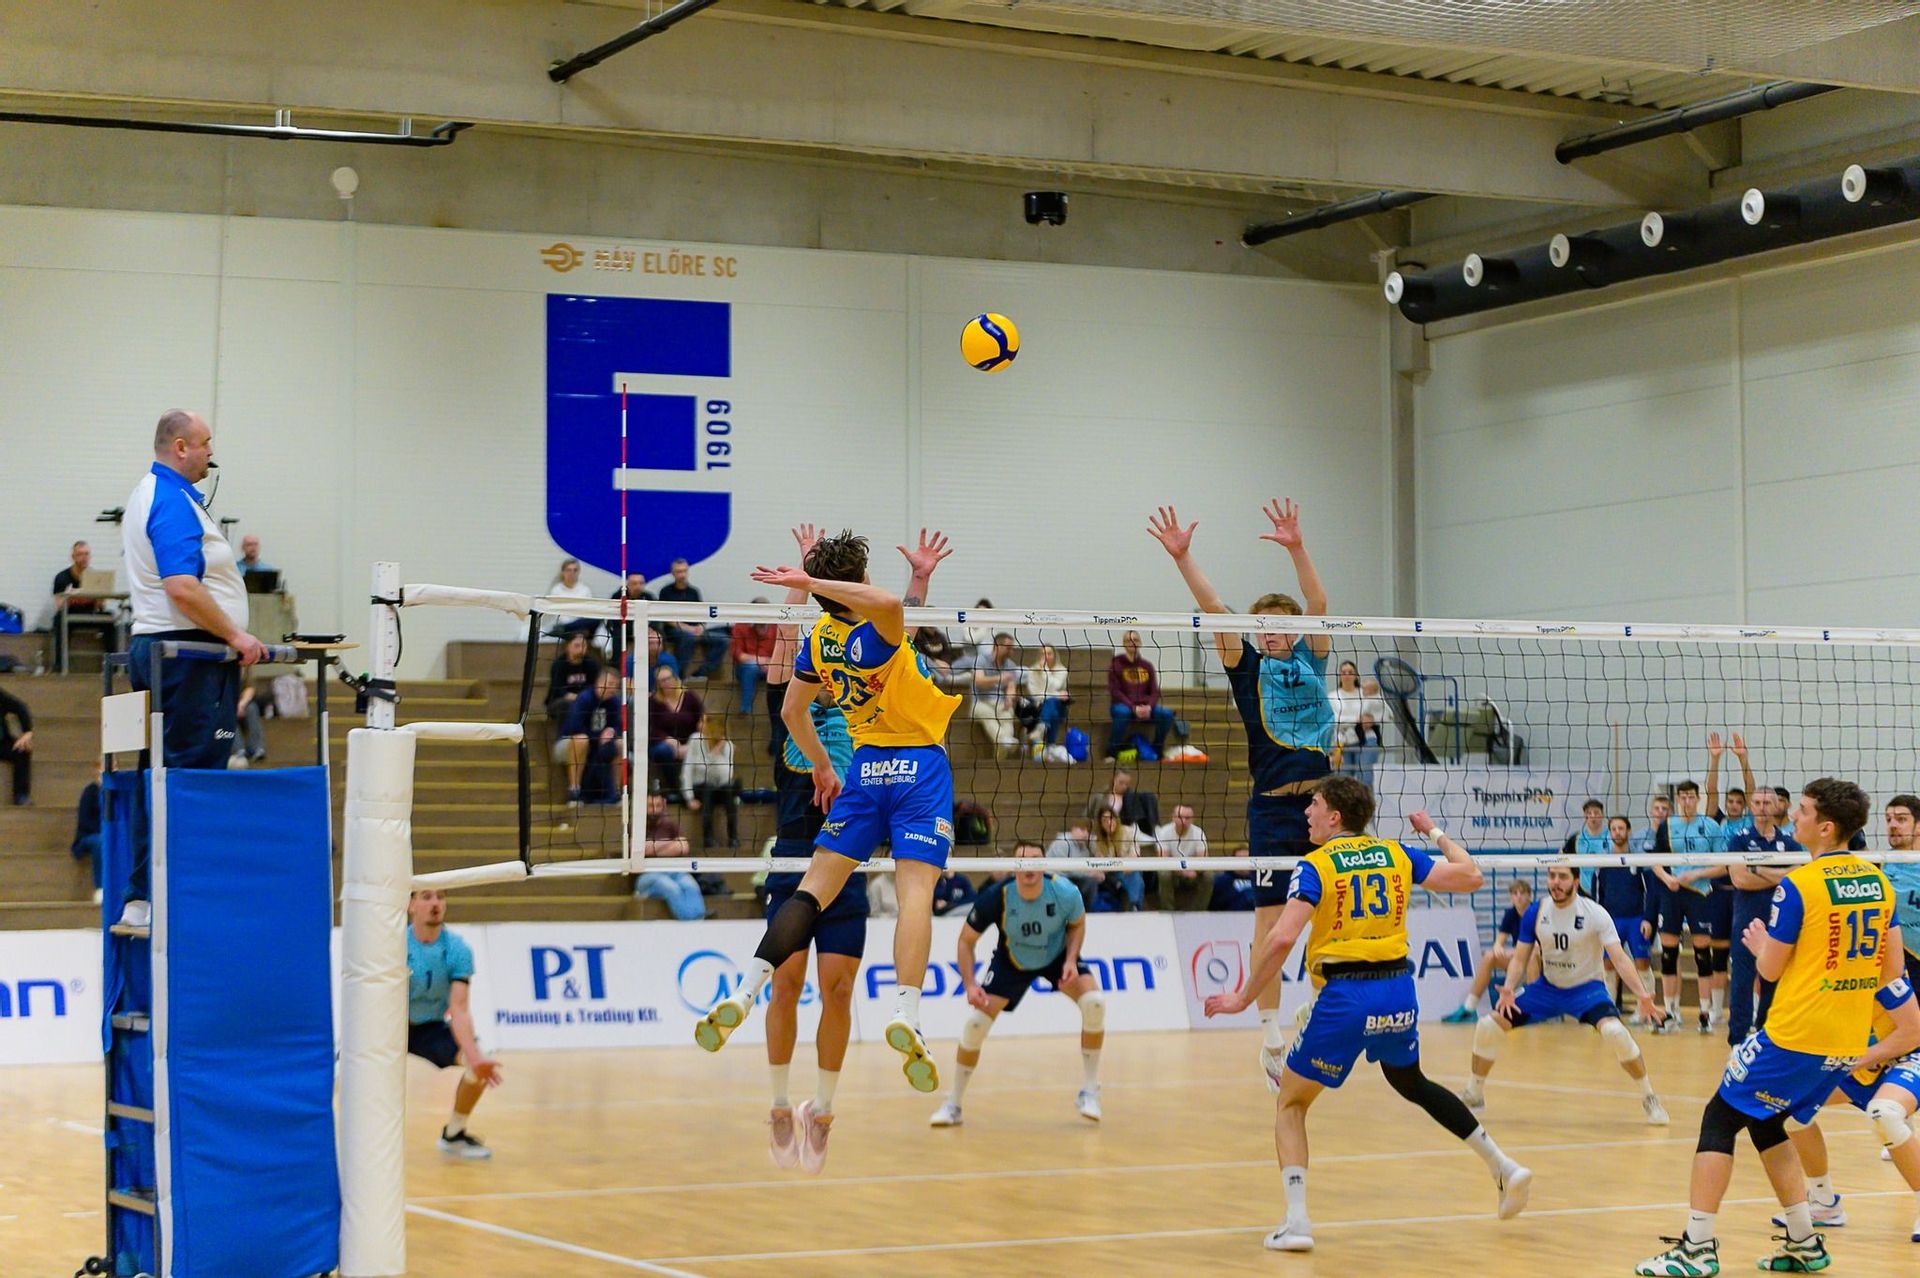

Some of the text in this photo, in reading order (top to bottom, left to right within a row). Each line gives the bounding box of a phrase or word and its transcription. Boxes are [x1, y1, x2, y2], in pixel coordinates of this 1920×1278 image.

[642, 247, 706, 276] ELŐRE
[713, 255, 738, 277] SC
[706, 400, 732, 471] 1909
[709, 607, 718, 618] E
[957, 612, 966, 623] E
[1192, 617, 1201, 628] E
[1415, 622, 1423, 632] E
[1624, 626, 1633, 637] E
[1823, 630, 1831, 641] E
[1281, 668, 1306, 688] 12
[1494, 817, 1554, 829] EXTRALIGA
[904, 832, 937, 846] ZADRUGA
[1256, 869, 1273, 887] 12
[1350, 873, 1390, 920] 13
[1833, 879, 1882, 900] kelag
[1021, 921, 1042, 937] 90
[1846, 908, 1881, 960] 15
[1553, 933, 1568, 951] 10
[1826, 912, 1841, 971] URBAS
[530, 945, 615, 1000] P&T
